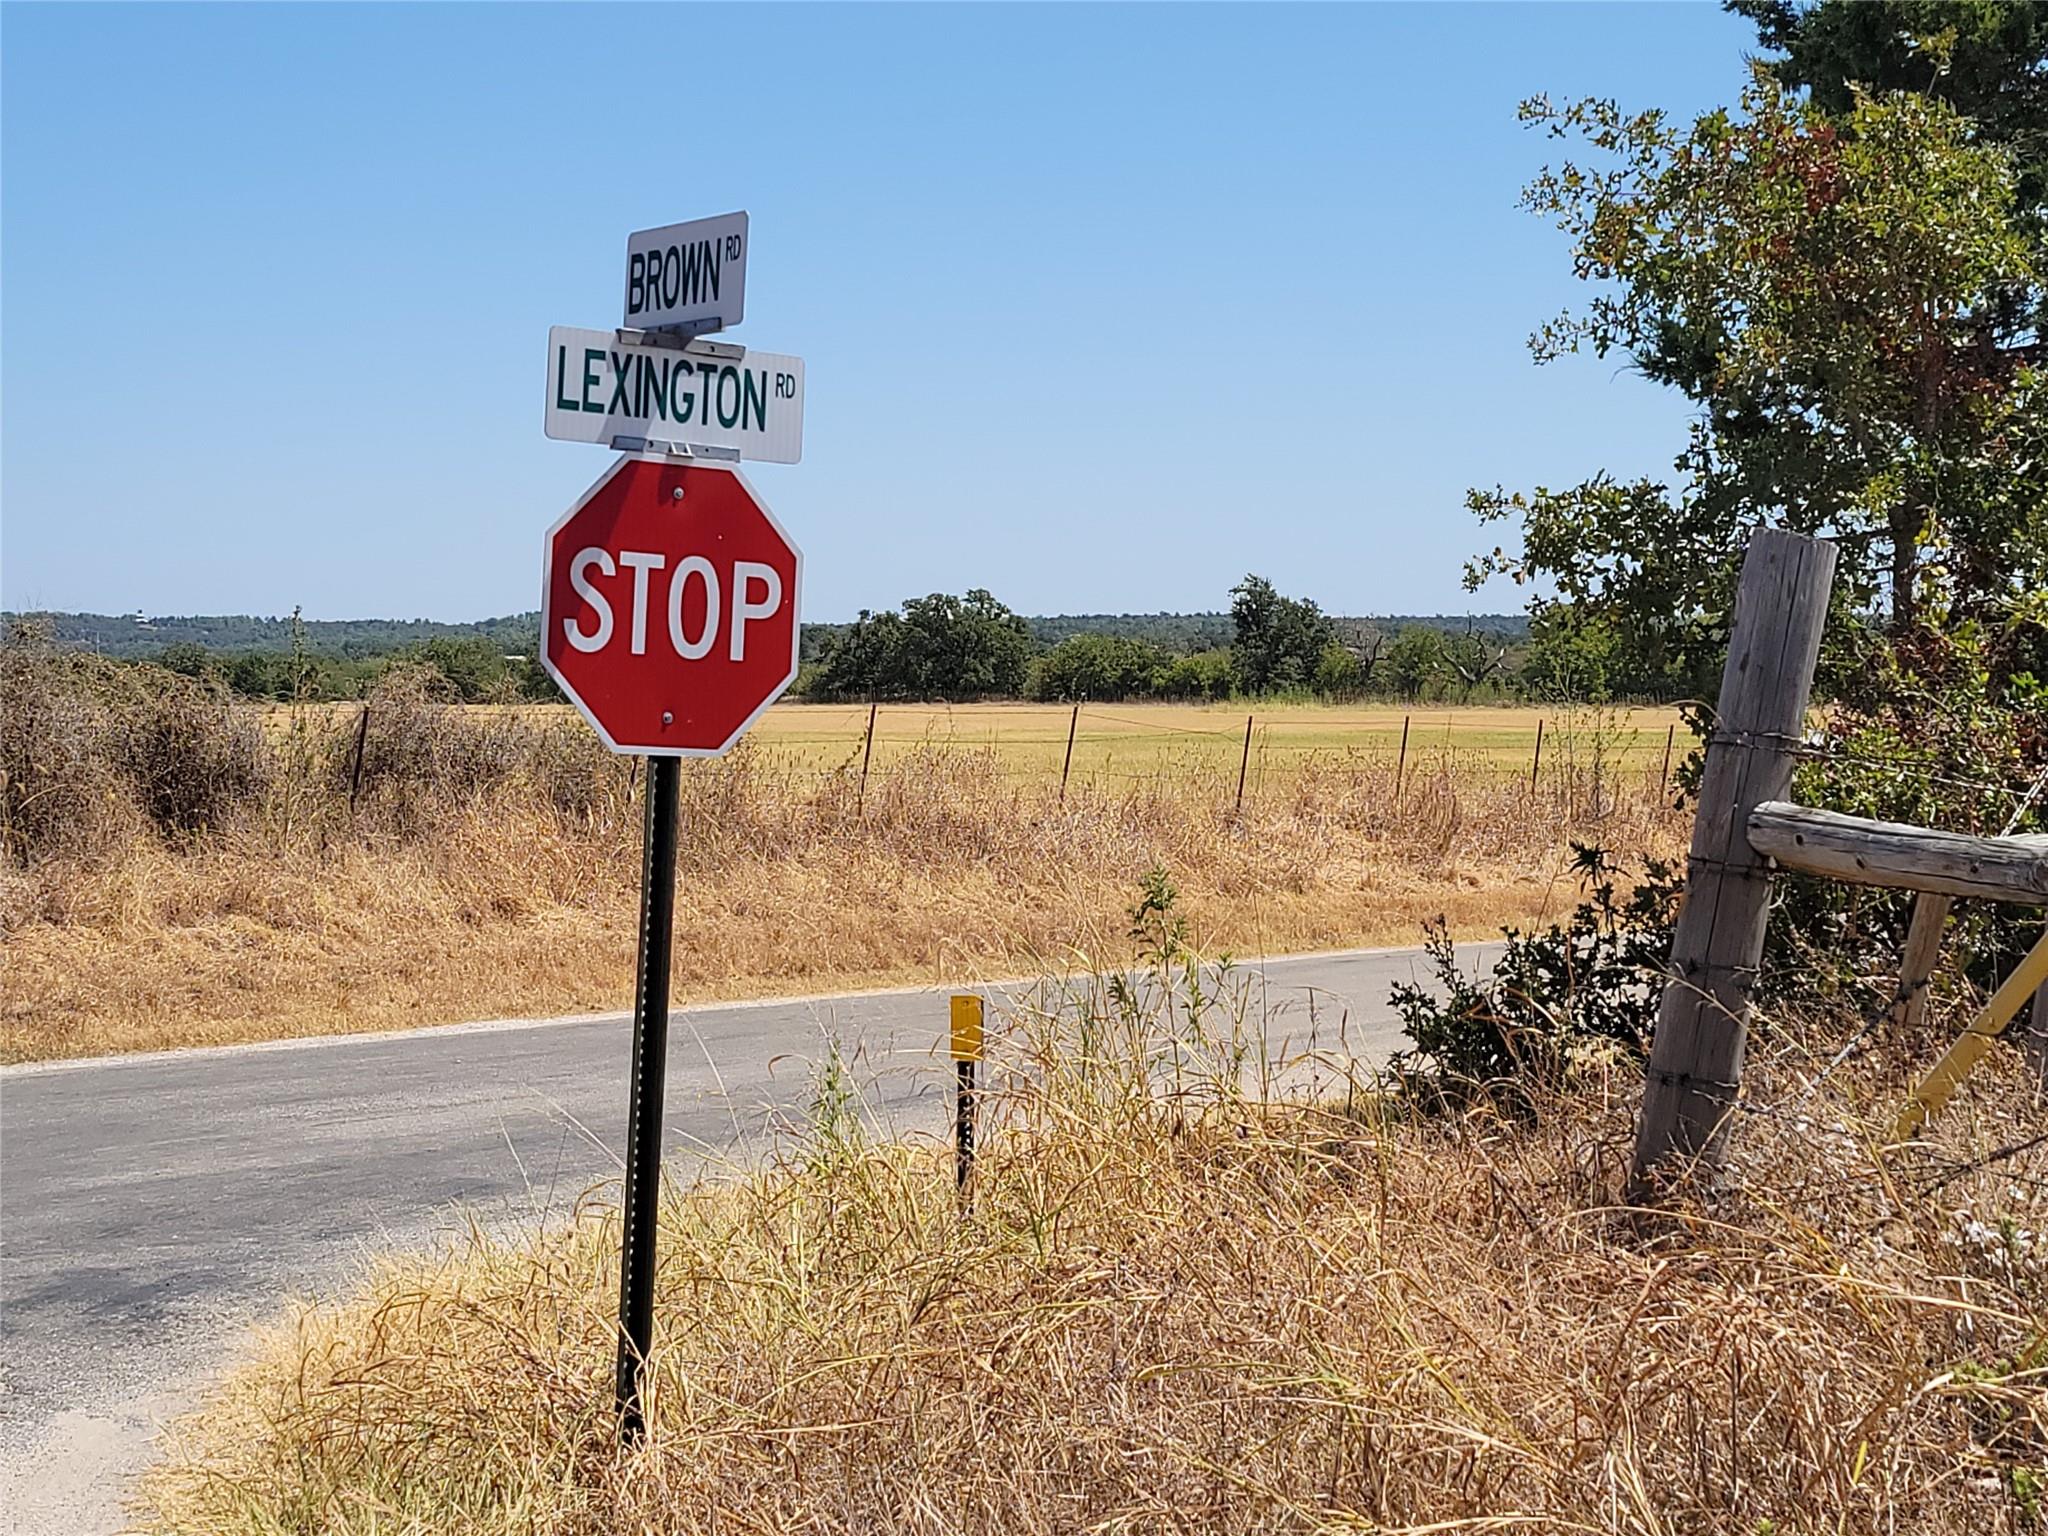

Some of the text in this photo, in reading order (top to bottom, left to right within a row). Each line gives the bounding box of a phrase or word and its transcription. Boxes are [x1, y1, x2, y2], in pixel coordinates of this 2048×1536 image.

[628, 234, 741, 314] BROWN RD
[556, 345, 796, 433] LEXINGTON RD
[563, 547, 782, 662] STOP
